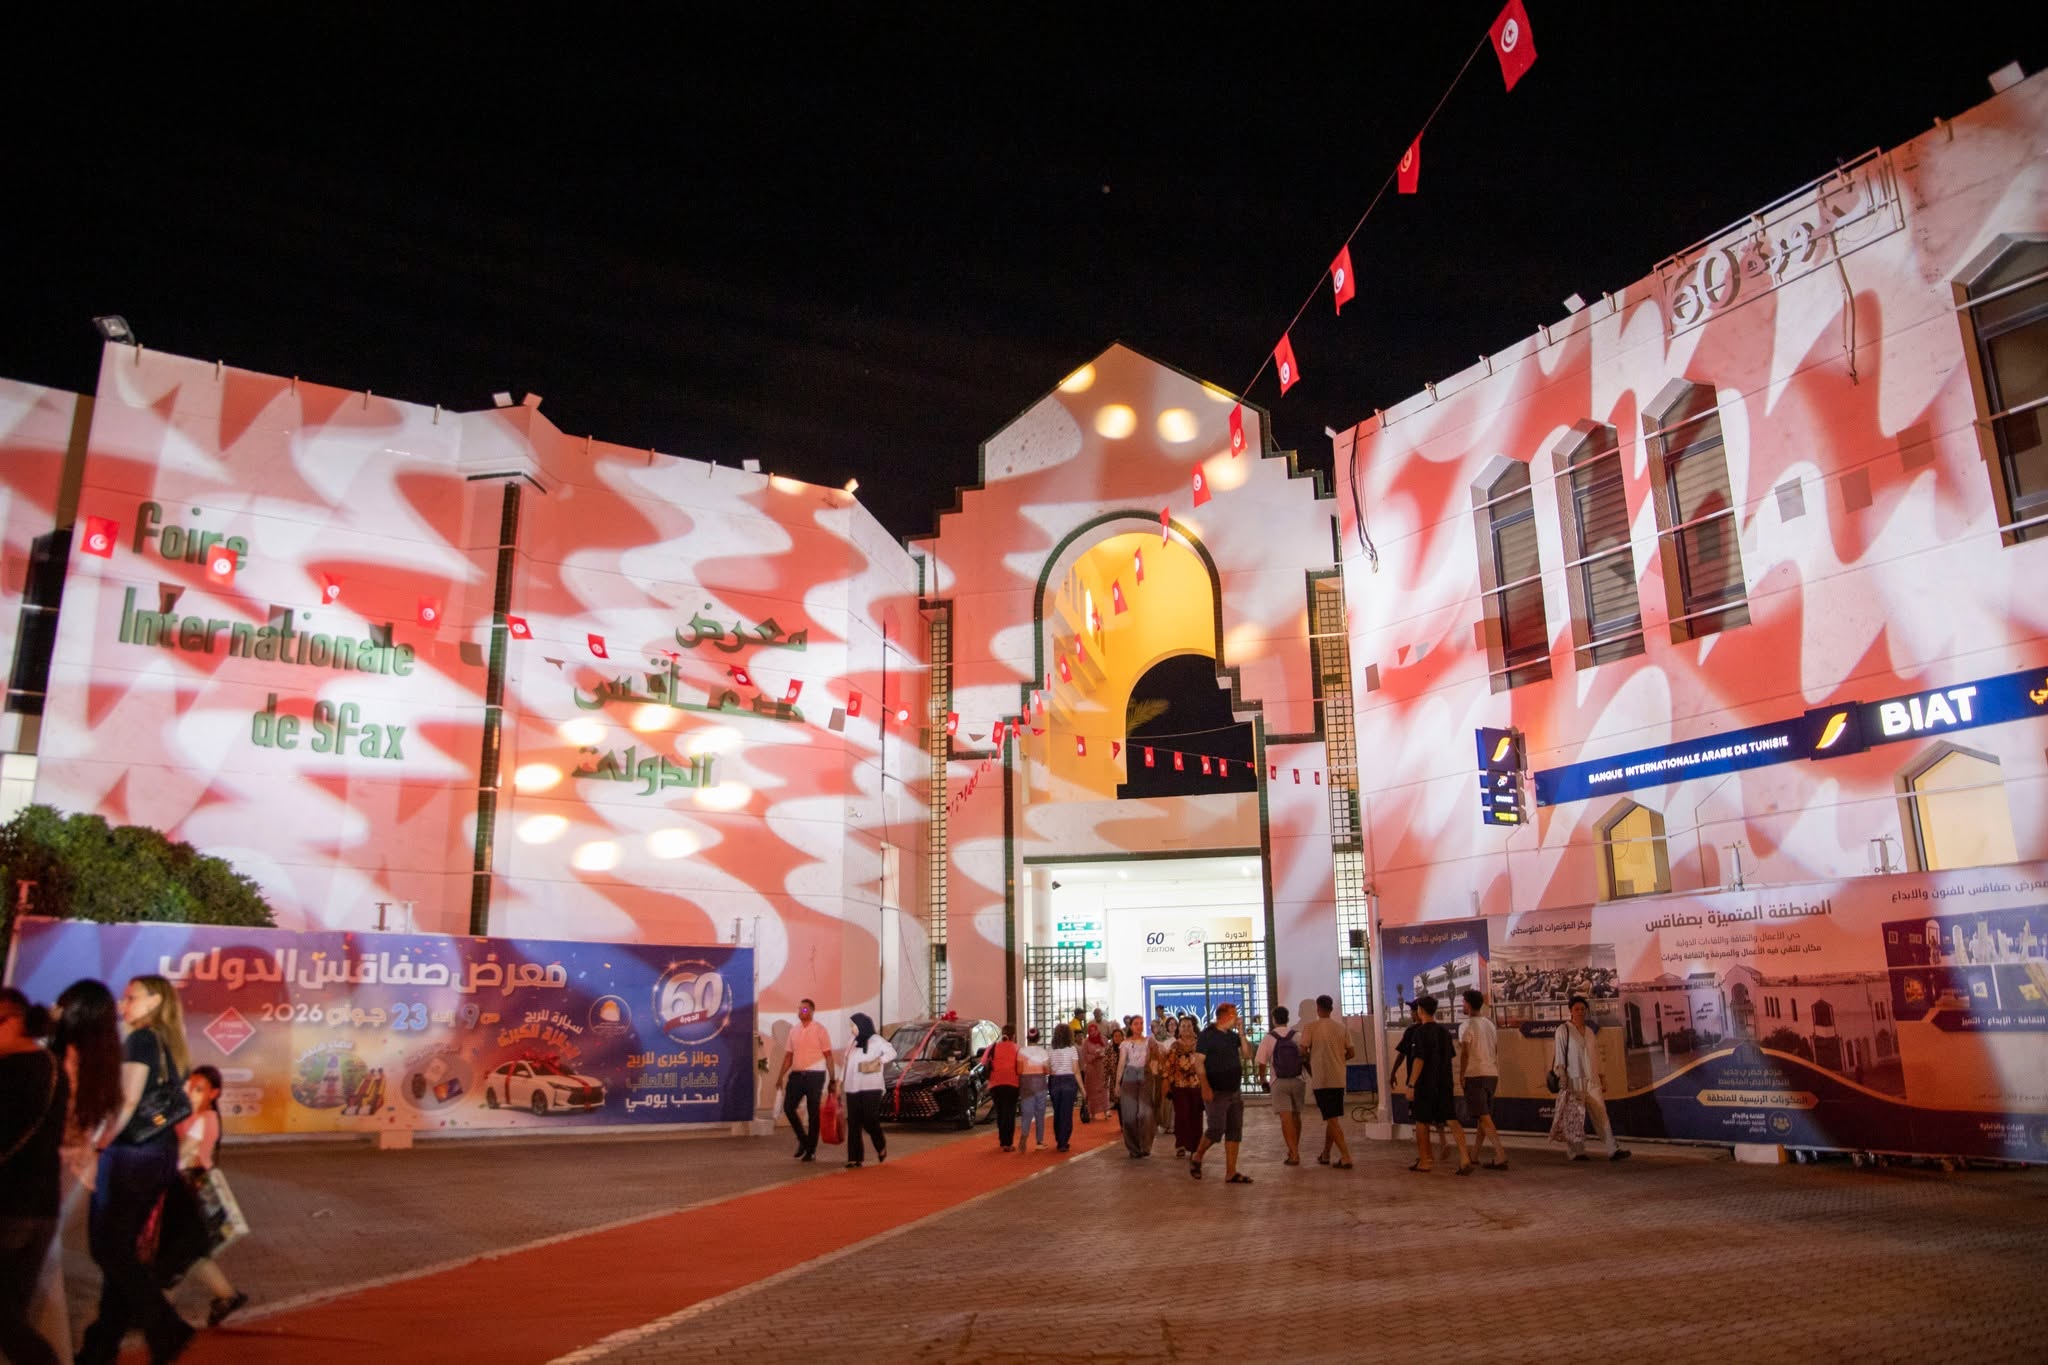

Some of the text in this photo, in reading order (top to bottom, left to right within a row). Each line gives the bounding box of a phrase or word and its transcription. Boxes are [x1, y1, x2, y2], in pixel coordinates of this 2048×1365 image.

[119, 586, 416, 676] Internationale
[675, 602, 809, 653] معرض
[573, 657, 805, 722] صفاقس
[252, 693, 300, 750] de
[1879, 686, 1977, 736] BIAT
[1588, 735, 1789, 784] BANQUE INTERNATIONALE ARABE DE TUNISIE
[1577, 920, 1592, 930] مركز
[1645, 899, 1832, 932] المنطقة المتميزة بصفاقس
[1146, 932, 1165, 945] 60
[1225, 931, 1248, 940] الدورة
[158, 946, 568, 996] معرض صفاقس الدولي
[261, 1002, 323, 1022] 2026
[662, 972, 723, 1023] 60
[391, 1002, 428, 1031] 23
[626, 1051, 655, 1068] للربح
[657, 1051, 688, 1068] كبرى
[625, 1093, 720, 1112] سحب يومي
